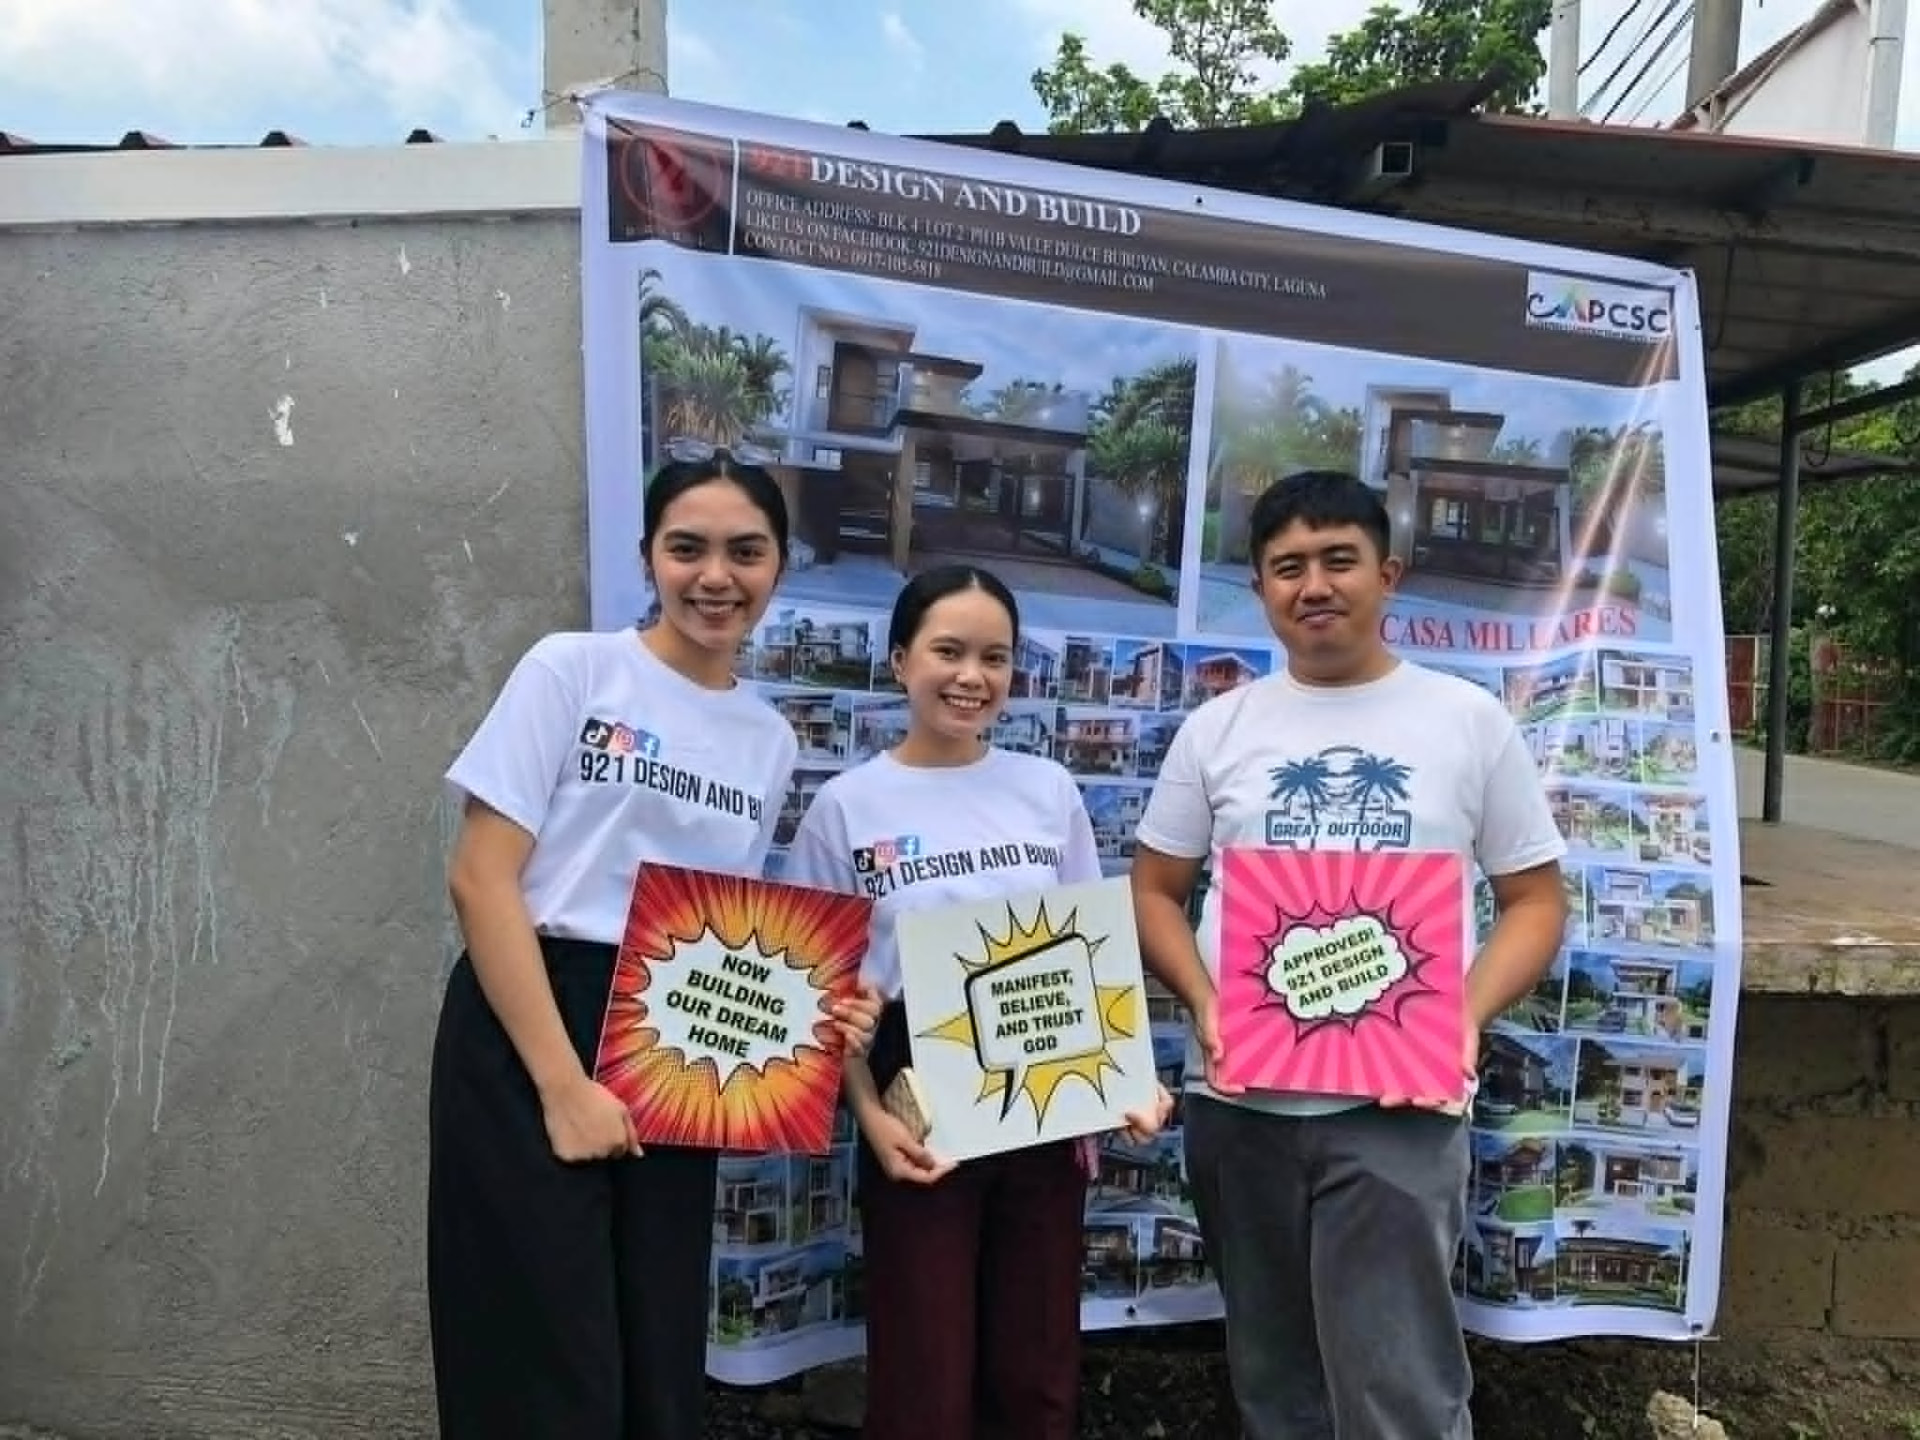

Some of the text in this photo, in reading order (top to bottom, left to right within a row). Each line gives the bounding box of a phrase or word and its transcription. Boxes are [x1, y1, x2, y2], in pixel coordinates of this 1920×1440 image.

[809, 156, 945, 202] DESIGN
[955, 181, 1027, 217] AND
[1038, 194, 1141, 236] BUILD
[744, 231, 815, 257] CONTACT
[745, 209, 781, 231] LIKE
[785, 216, 804, 236] US
[806, 223, 830, 242] ON
[924, 219, 953, 239] LOT
[1274, 275, 1327, 301] LAGUNA
[1380, 604, 1637, 650] CASA MILLARES
[580, 752, 624, 783] 921
[633, 757, 702, 804] DESIGN
[704, 780, 744, 816] AND
[1273, 822, 1403, 838] GREAT OUTDOOR
[865, 867, 896, 900] 921
[900, 850, 976, 886] DESIGN
[980, 844, 1021, 871] AND
[722, 953, 772, 983] NOW
[1283, 927, 1375, 972] APPROVED!
[1286, 944, 1385, 991] 921 DESIGN
[687, 968, 786, 1016] BUILDING
[991, 969, 1074, 998] MANIFEST,
[1000, 991, 1071, 1017] BELIEVE,
[1299, 963, 1389, 1008] AND BUILD
[666, 989, 788, 1044] OUR DREAM
[996, 1008, 1084, 1040] AND TRUST
[688, 1024, 751, 1058] HOME
[1023, 1035, 1058, 1053] GOD
